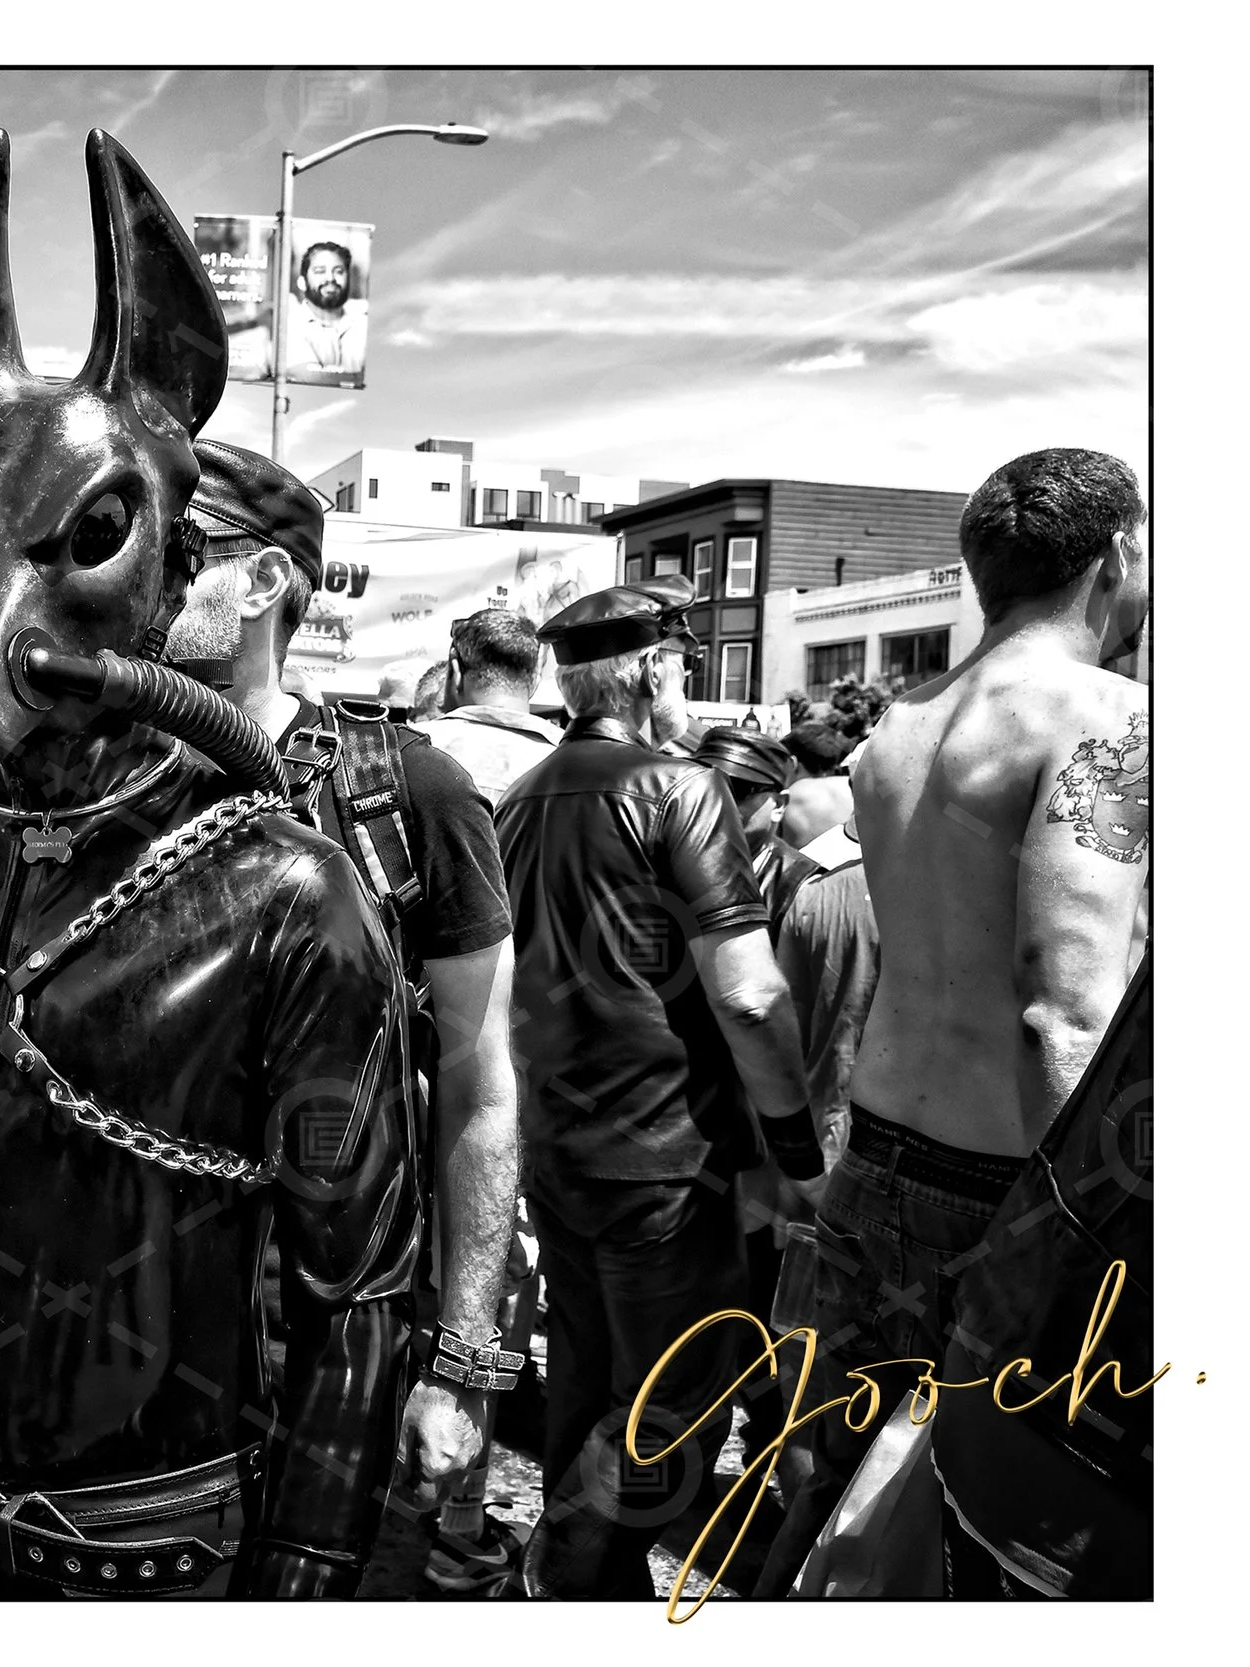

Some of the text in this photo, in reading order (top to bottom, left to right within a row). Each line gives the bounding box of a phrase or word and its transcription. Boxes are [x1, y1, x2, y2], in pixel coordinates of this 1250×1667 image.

[317, 561, 370, 599] ey
[391, 609, 433, 623] WOLF
[296, 622, 342, 638] ELLA
[351, 791, 393, 812] CHROME
